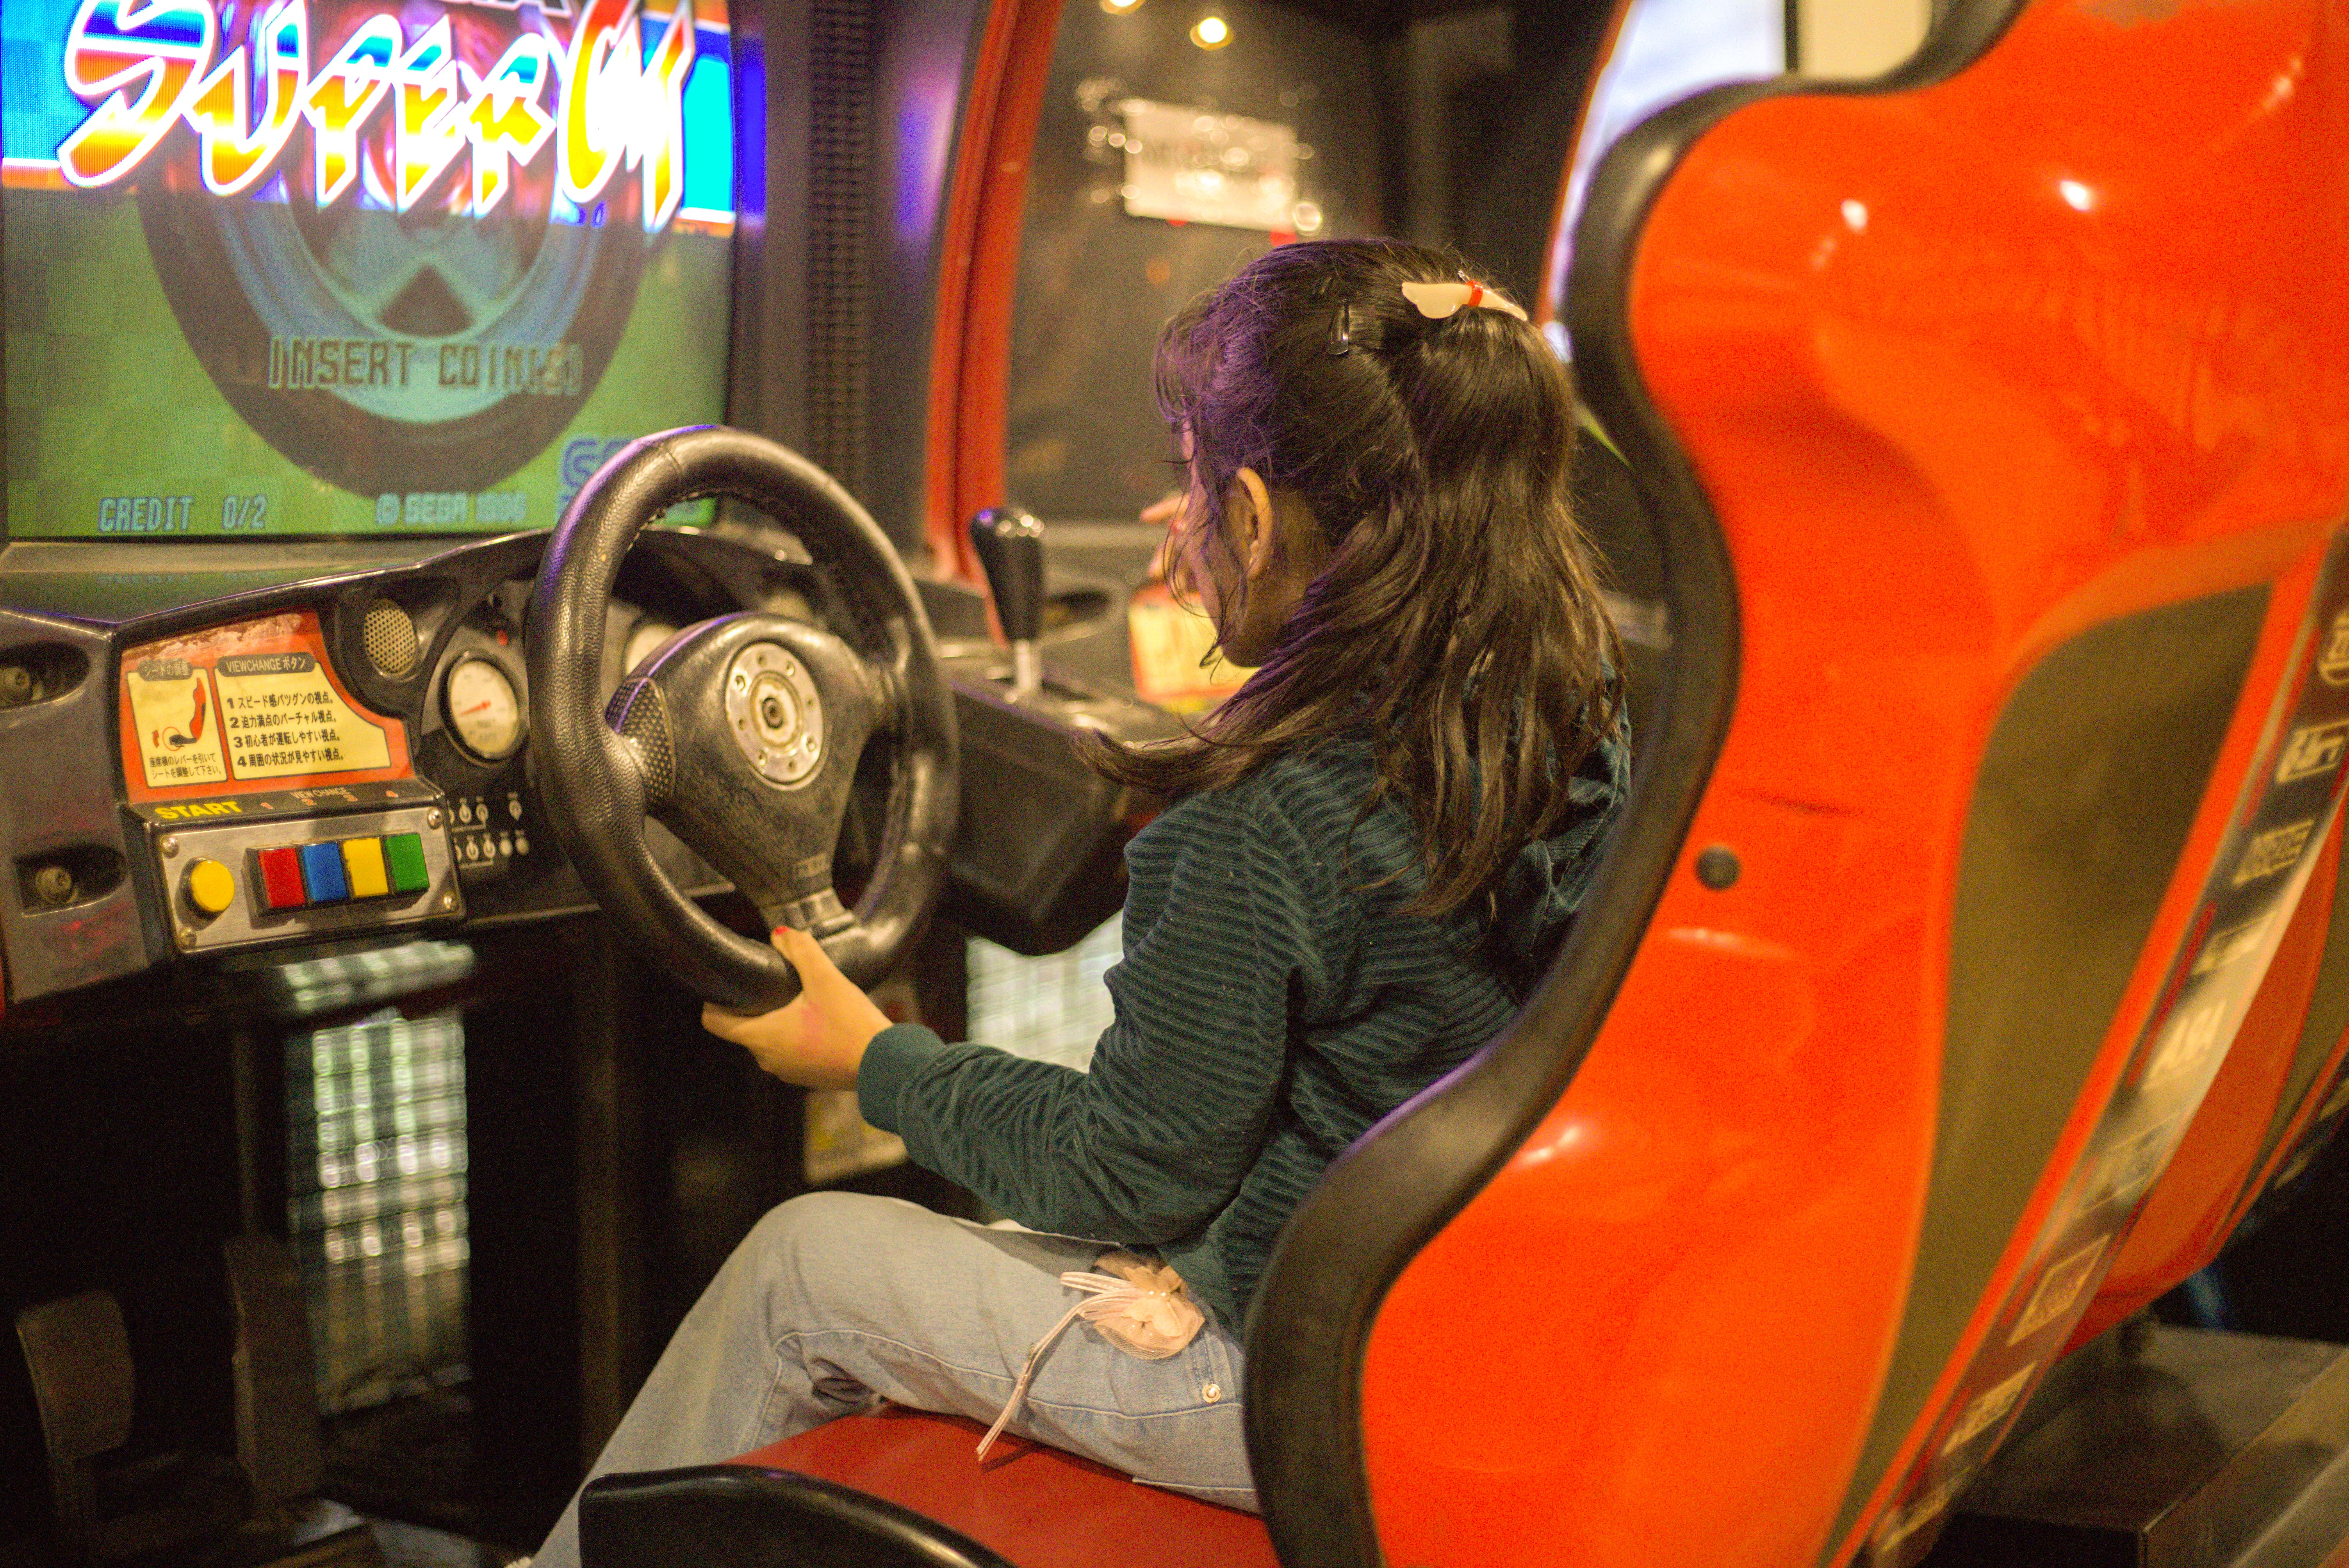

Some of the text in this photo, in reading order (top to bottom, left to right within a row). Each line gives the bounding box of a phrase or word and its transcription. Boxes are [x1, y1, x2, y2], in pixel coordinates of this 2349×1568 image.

[269, 336, 415, 390] INSERT
[98, 494, 269, 533] CREDIT 0/2
[404, 491, 468, 524] SEGA
[226, 655, 305, 672] VIEWCHANGE ボタン
[226, 697, 234, 709] 1
[229, 716, 240, 729] 2
[234, 736, 244, 748] 3
[237, 756, 247, 767] 4
[154, 801, 242, 819] START
